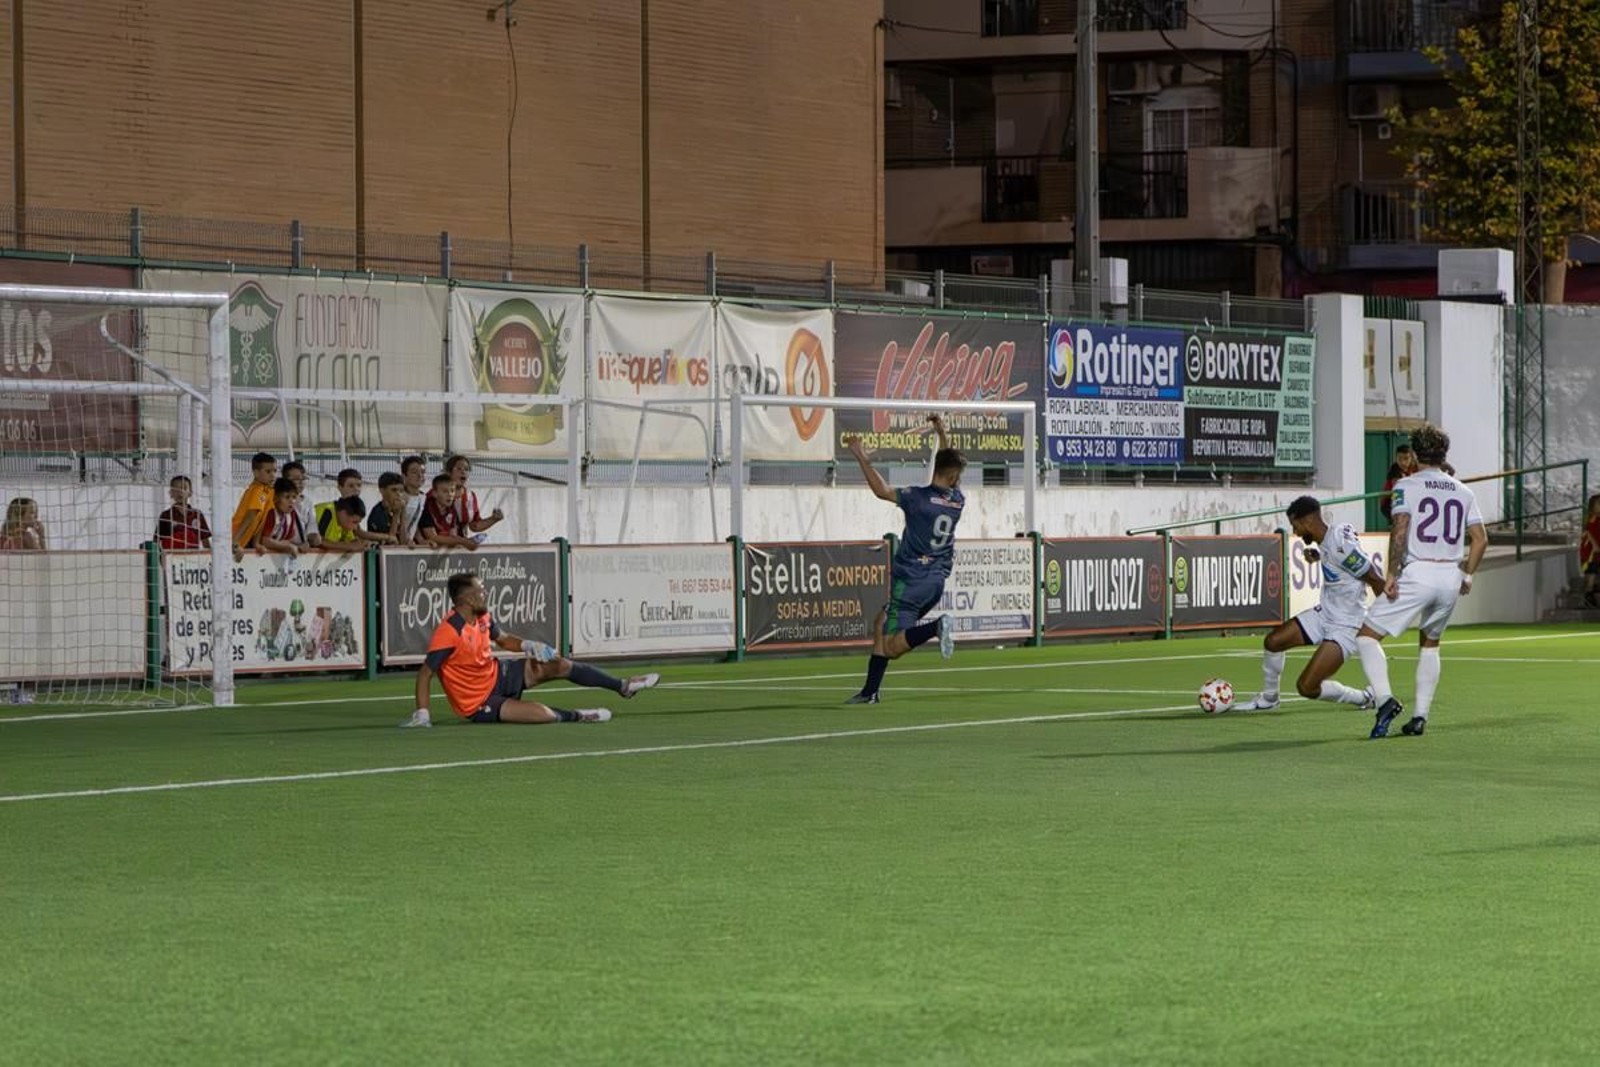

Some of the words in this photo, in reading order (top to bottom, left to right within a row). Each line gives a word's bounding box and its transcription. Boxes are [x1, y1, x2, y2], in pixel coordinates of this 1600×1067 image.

[489, 355, 542, 379] VALLEJO
[1076, 328, 1179, 386] Rotinser
[1205, 341, 1281, 382] BORYTEX
[873, 321, 1028, 432] Viking
[1049, 400, 1072, 414] ROPA
[1074, 401, 1110, 416] LABORAL
[1117, 402, 1179, 417] MERCHANDISING
[1065, 440, 1081, 456] 953
[1083, 441, 1093, 456] 34
[1094, 441, 1105, 457] 23
[1106, 441, 1117, 457] 80
[1131, 441, 1146, 457] 622
[1147, 441, 1157, 457] 26
[1158, 442, 1168, 457] 07
[1169, 442, 1178, 457] 11
[1424, 480, 1456, 491] MAURO
[930, 515, 953, 548] 9
[1416, 496, 1464, 545] 20
[315, 570, 333, 587] 641
[751, 553, 822, 595] stella
[827, 565, 886, 587] CONFORT
[1065, 557, 1144, 613] IMPULSO27
[1192, 555, 1264, 608] IMPULSO27
[812, 601, 820, 618] A
[823, 600, 862, 617] MEDIDA
[176, 616, 193, 637] de
[186, 646, 195, 668] y
